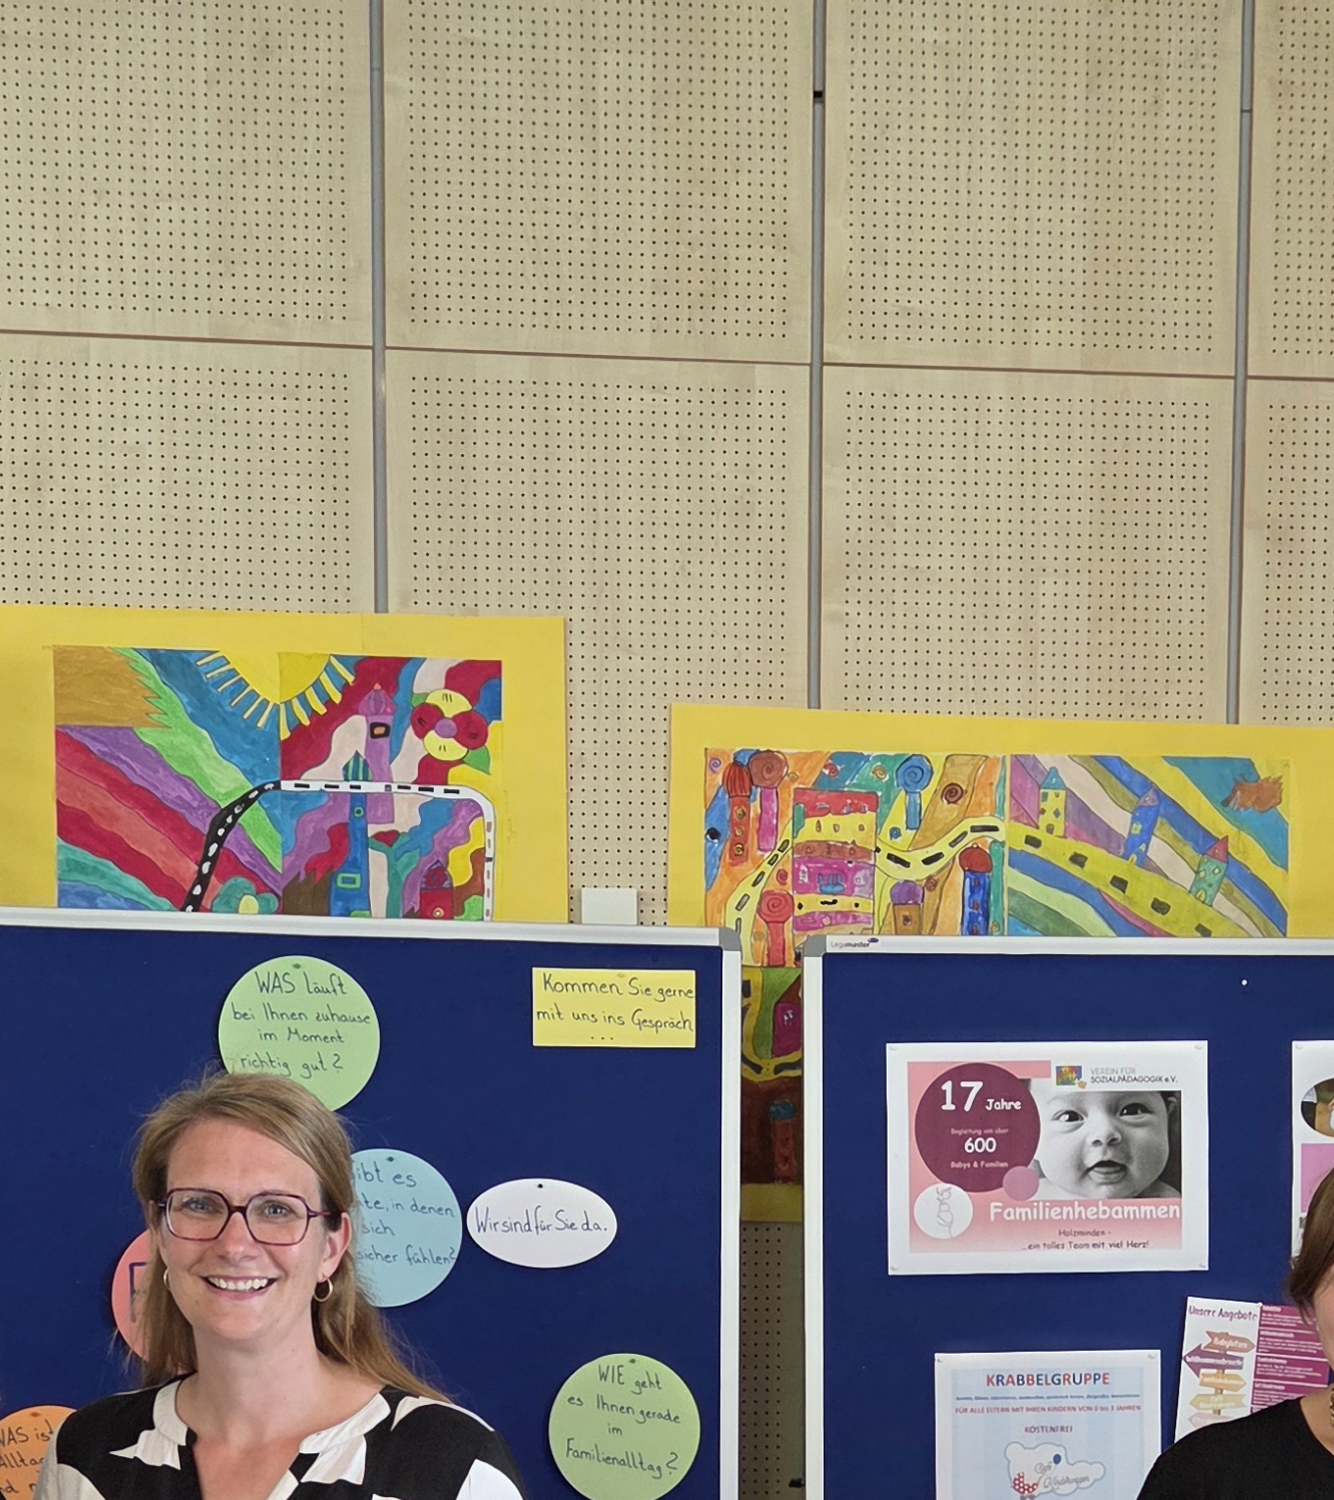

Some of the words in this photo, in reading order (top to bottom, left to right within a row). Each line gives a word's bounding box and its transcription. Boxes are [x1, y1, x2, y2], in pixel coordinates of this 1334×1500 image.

[254, 971, 296, 994] WAS
[303, 971, 347, 995] läuft
[543, 972, 623, 996] Kommen
[628, 977, 652, 996] Sie
[653, 986, 694, 1002] gerne
[231, 1002, 255, 1021] bei
[262, 1002, 308, 1021] Ihnen
[315, 1004, 371, 1024] zuhause
[536, 1002, 564, 1021] mit
[572, 1011, 598, 1024] uns
[603, 1010, 625, 1026] ins
[631, 1008, 694, 1034] Gespräch
[258, 1029, 277, 1040] im
[286, 1027, 345, 1043] Moment
[240, 1052, 292, 1077] richtig
[941, 1080, 983, 1112] 17
[985, 1098, 1021, 1111] Jahre
[964, 1137, 996, 1153] 600
[393, 1173, 417, 1188] es
[410, 1197, 455, 1217] denen
[990, 1201, 1180, 1222] Familienhebammen
[361, 1219, 395, 1236] sich
[1189, 1305, 1216, 1318] Unsere
[1218, 1308, 1258, 1321] Angebote
[598, 1364, 625, 1385] WIE
[631, 1371, 662, 1395] geht
[986, 1373, 1110, 1387] KRABBELGRUPPE
[567, 1395, 583, 1406] es
[596, 1394, 635, 1415] Ihnen
[635, 1409, 681, 1424] gerade
[607, 1423, 622, 1436] im
[1024, 1425, 1073, 1433] KOSTENFREI
[566, 1438, 663, 1480] Familienalltag
